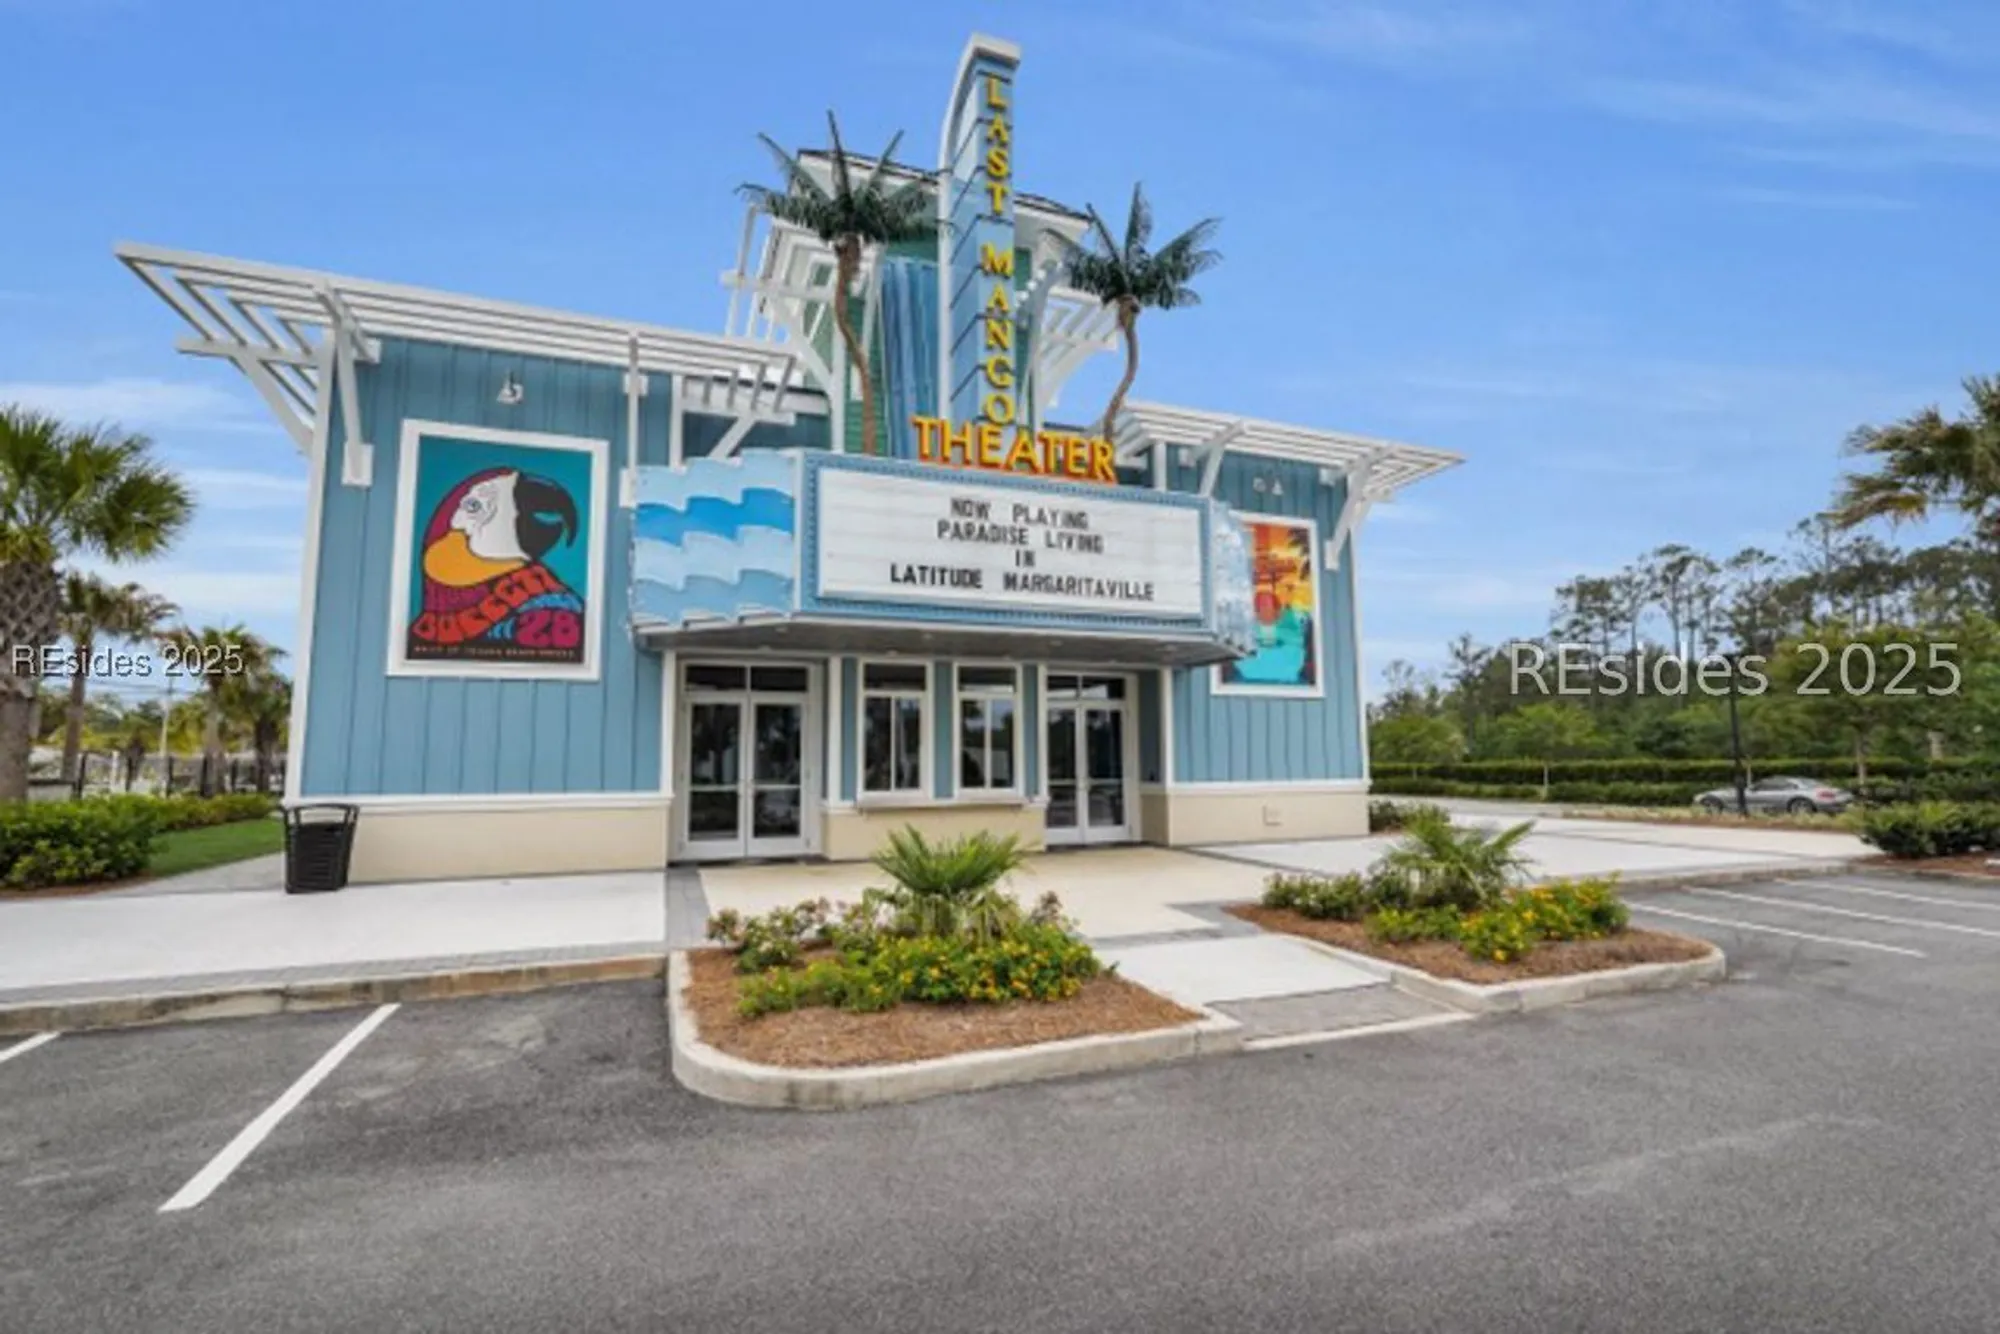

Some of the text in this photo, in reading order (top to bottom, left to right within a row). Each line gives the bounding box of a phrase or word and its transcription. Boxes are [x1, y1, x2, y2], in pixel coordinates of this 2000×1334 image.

[981, 76, 1013, 426] LAST MANGO
[912, 416, 1117, 483] THEATER
[951, 498, 1089, 530] NOW PLAYING
[937, 520, 1104, 554] PARADISE LIVING
[1015, 549, 1036, 567] IN
[890, 564, 1155, 600] LATITUDE MARGARITAVILLE
